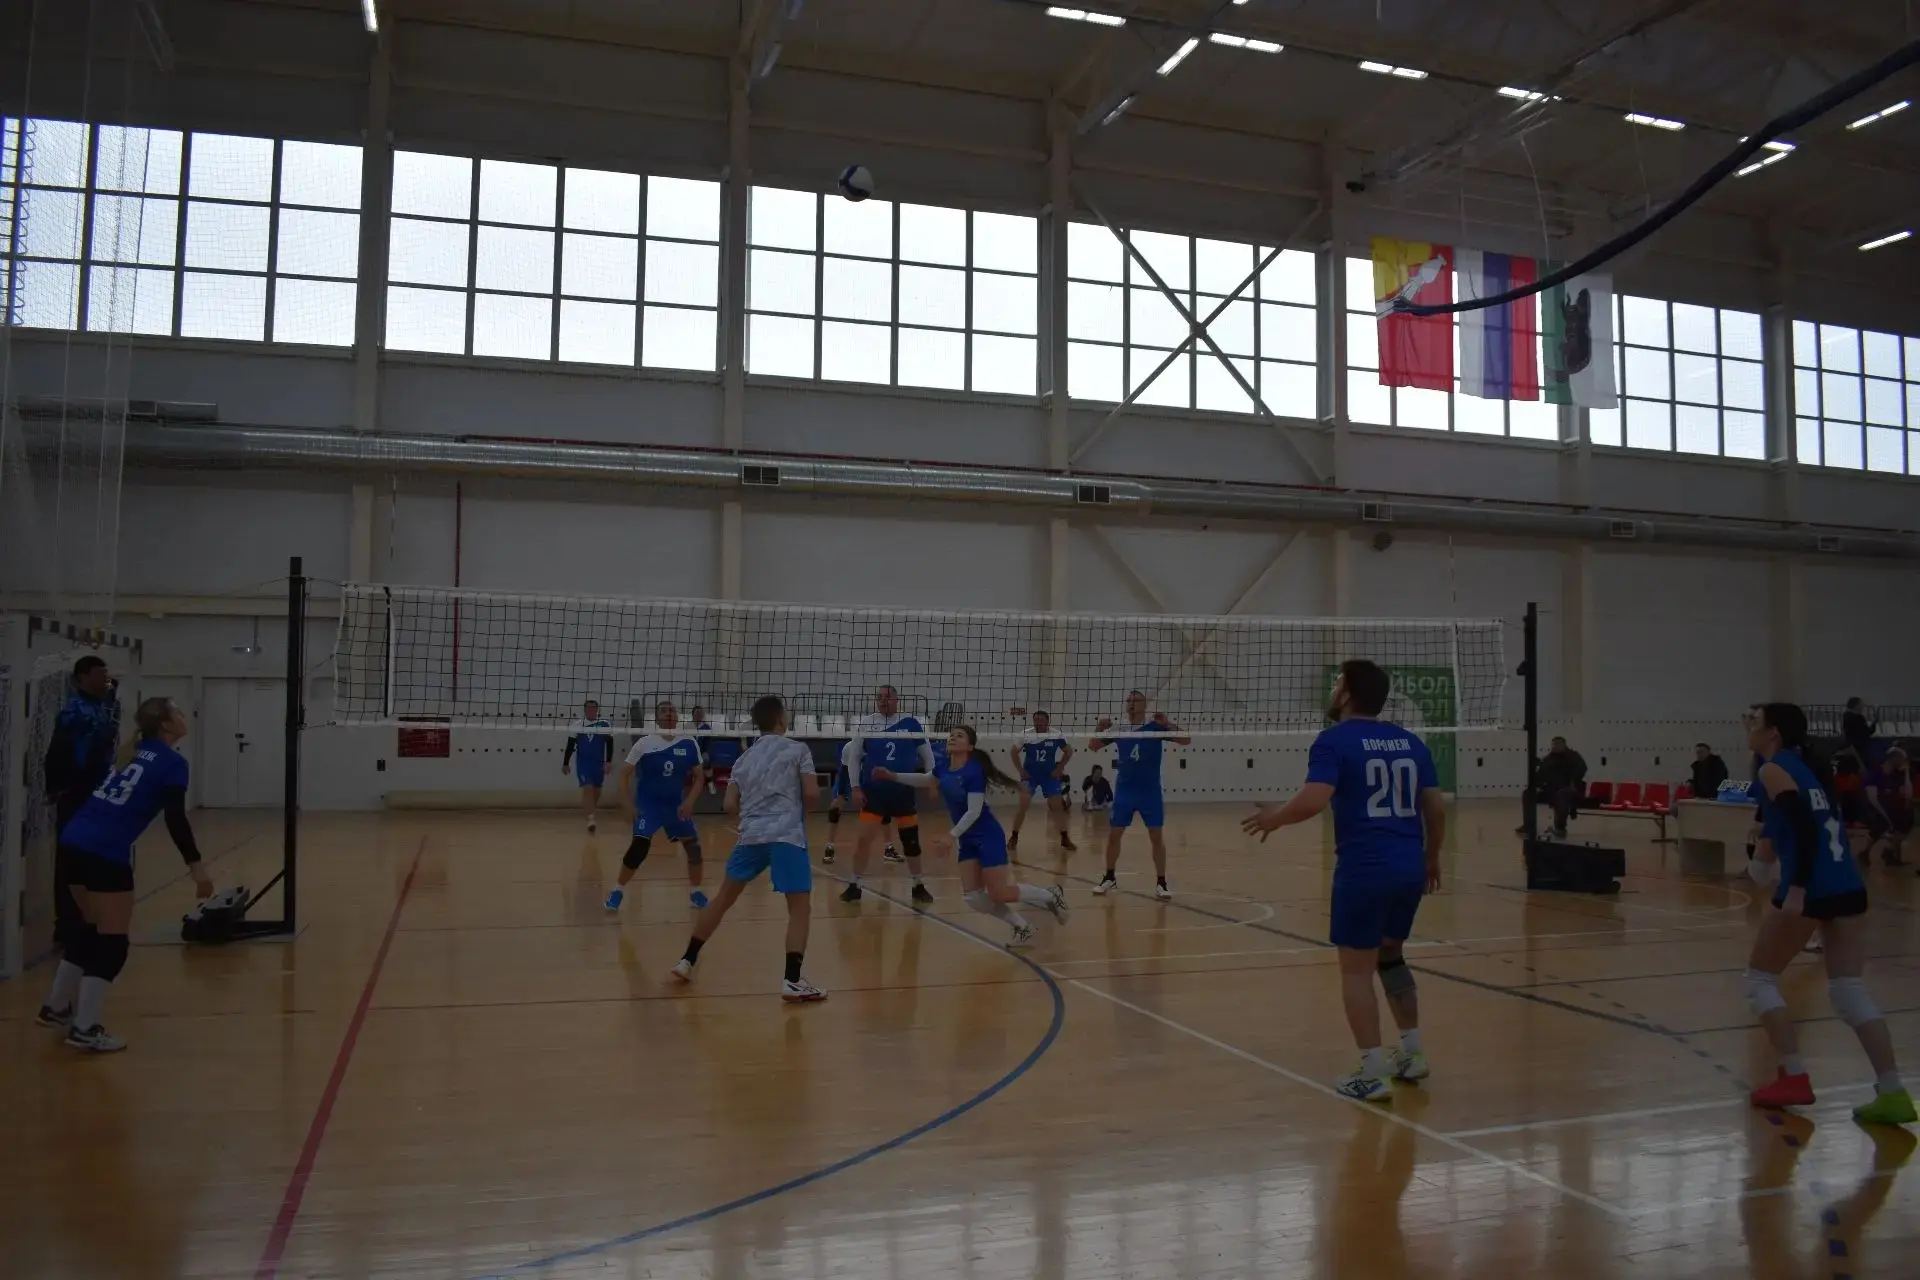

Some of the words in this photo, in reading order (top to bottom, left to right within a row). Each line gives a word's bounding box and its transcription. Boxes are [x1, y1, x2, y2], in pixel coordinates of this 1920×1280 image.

[885, 741, 896, 761] 2
[1035, 749, 1047, 762] 12
[1130, 743, 1139, 762] 4
[92, 763, 144, 805] 13
[1365, 758, 1418, 818] 20
